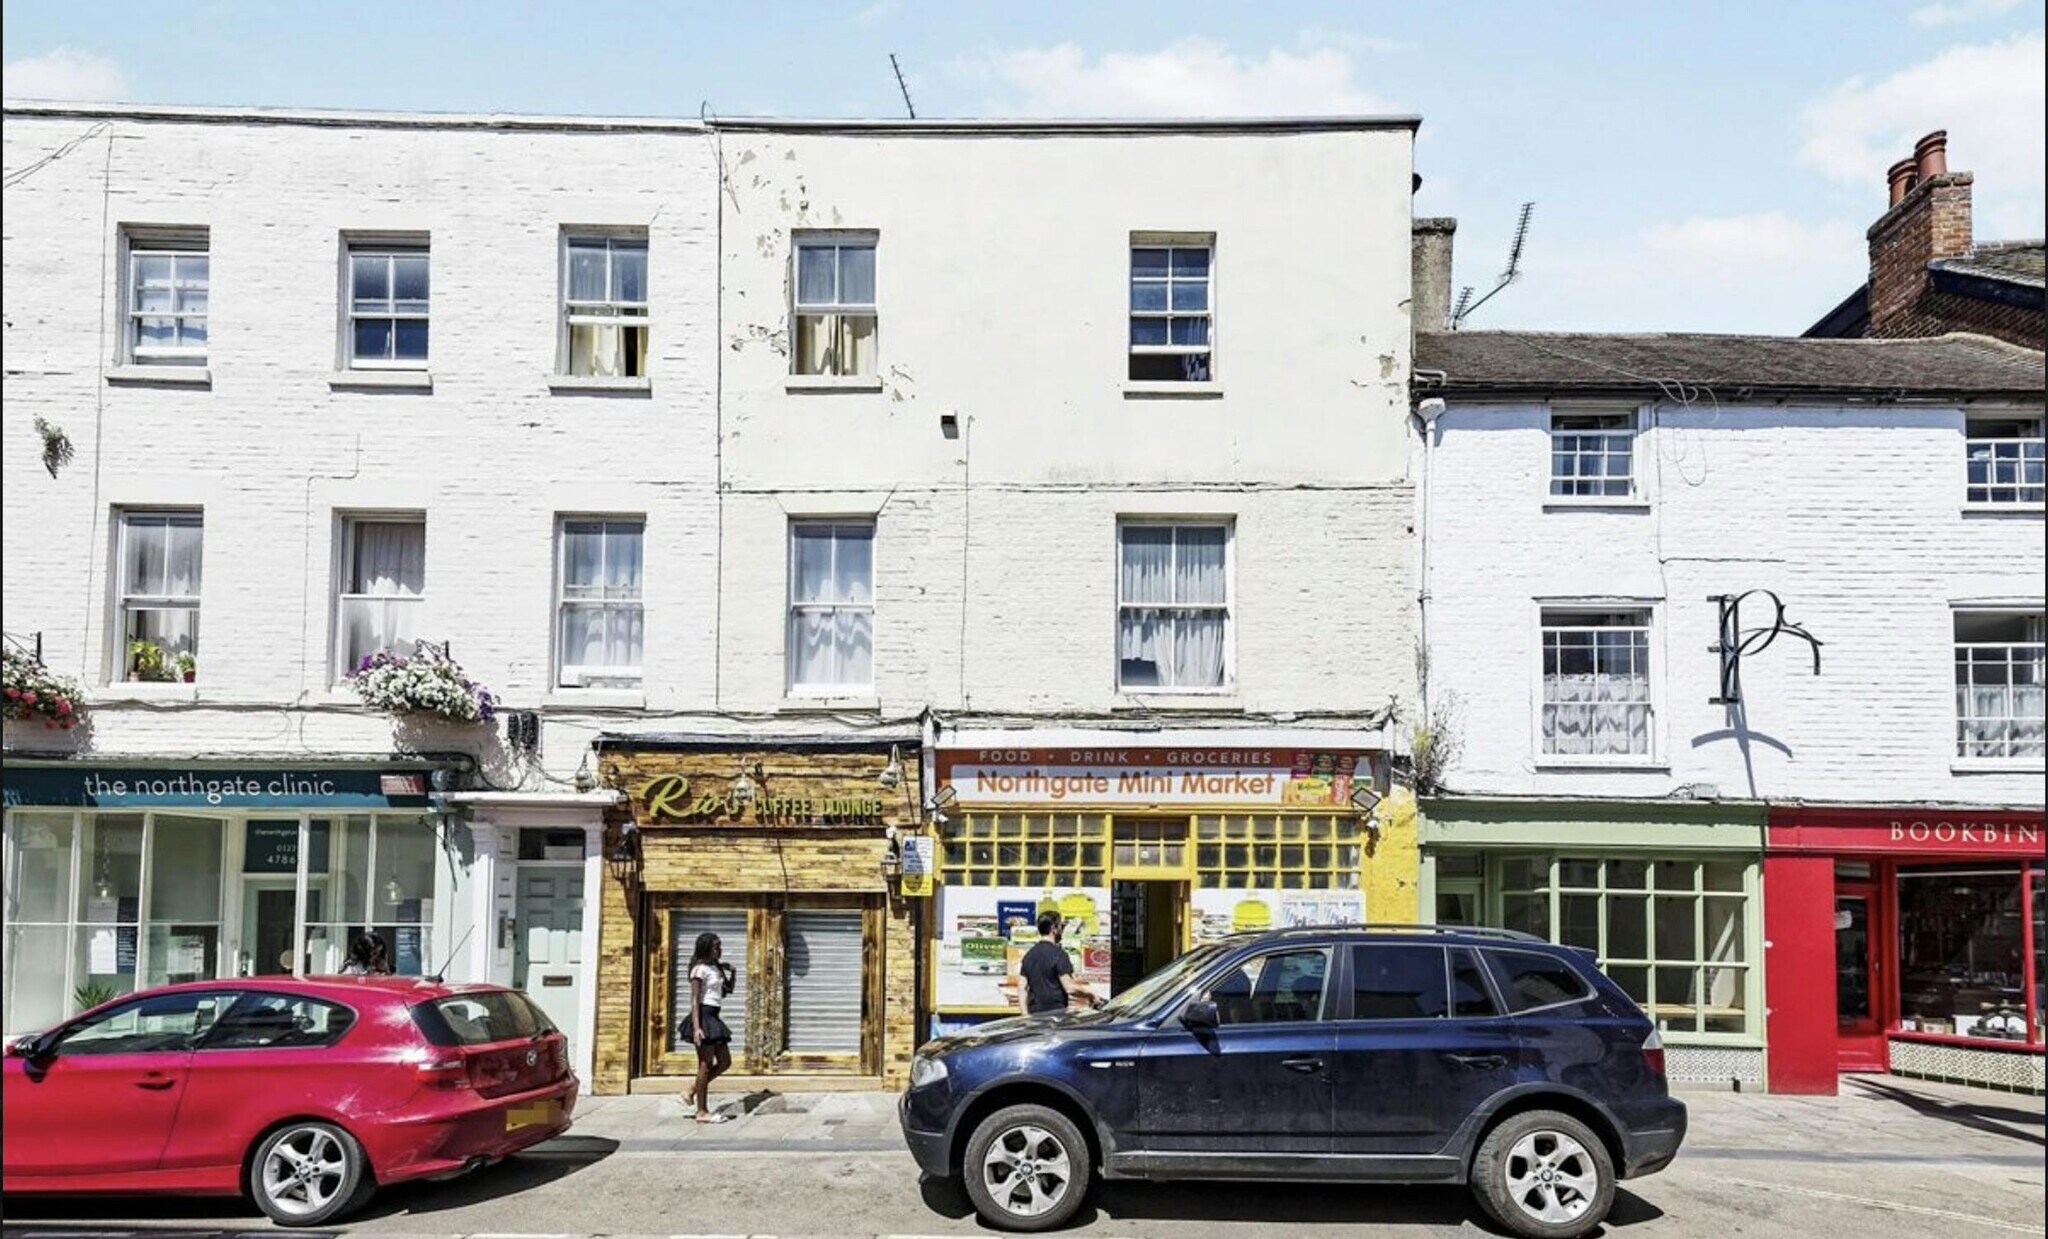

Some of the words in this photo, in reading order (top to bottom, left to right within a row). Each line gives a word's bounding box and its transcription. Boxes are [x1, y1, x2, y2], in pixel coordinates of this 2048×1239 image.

[979, 750, 1031, 763] FOOD
[1070, 751, 1129, 764] DRINK
[1167, 751, 1272, 764] GROCERIES
[84, 772, 127, 796] the
[135, 772, 261, 805] northgate
[267, 773, 335, 796] clinic
[977, 769, 1109, 799] Northgate
[1118, 770, 1173, 794] Mini
[1181, 770, 1275, 795] Market
[754, 798, 811, 816] COFFEE
[822, 798, 883, 816] LOUNGE
[1890, 821, 2038, 844] BOOKBIN
